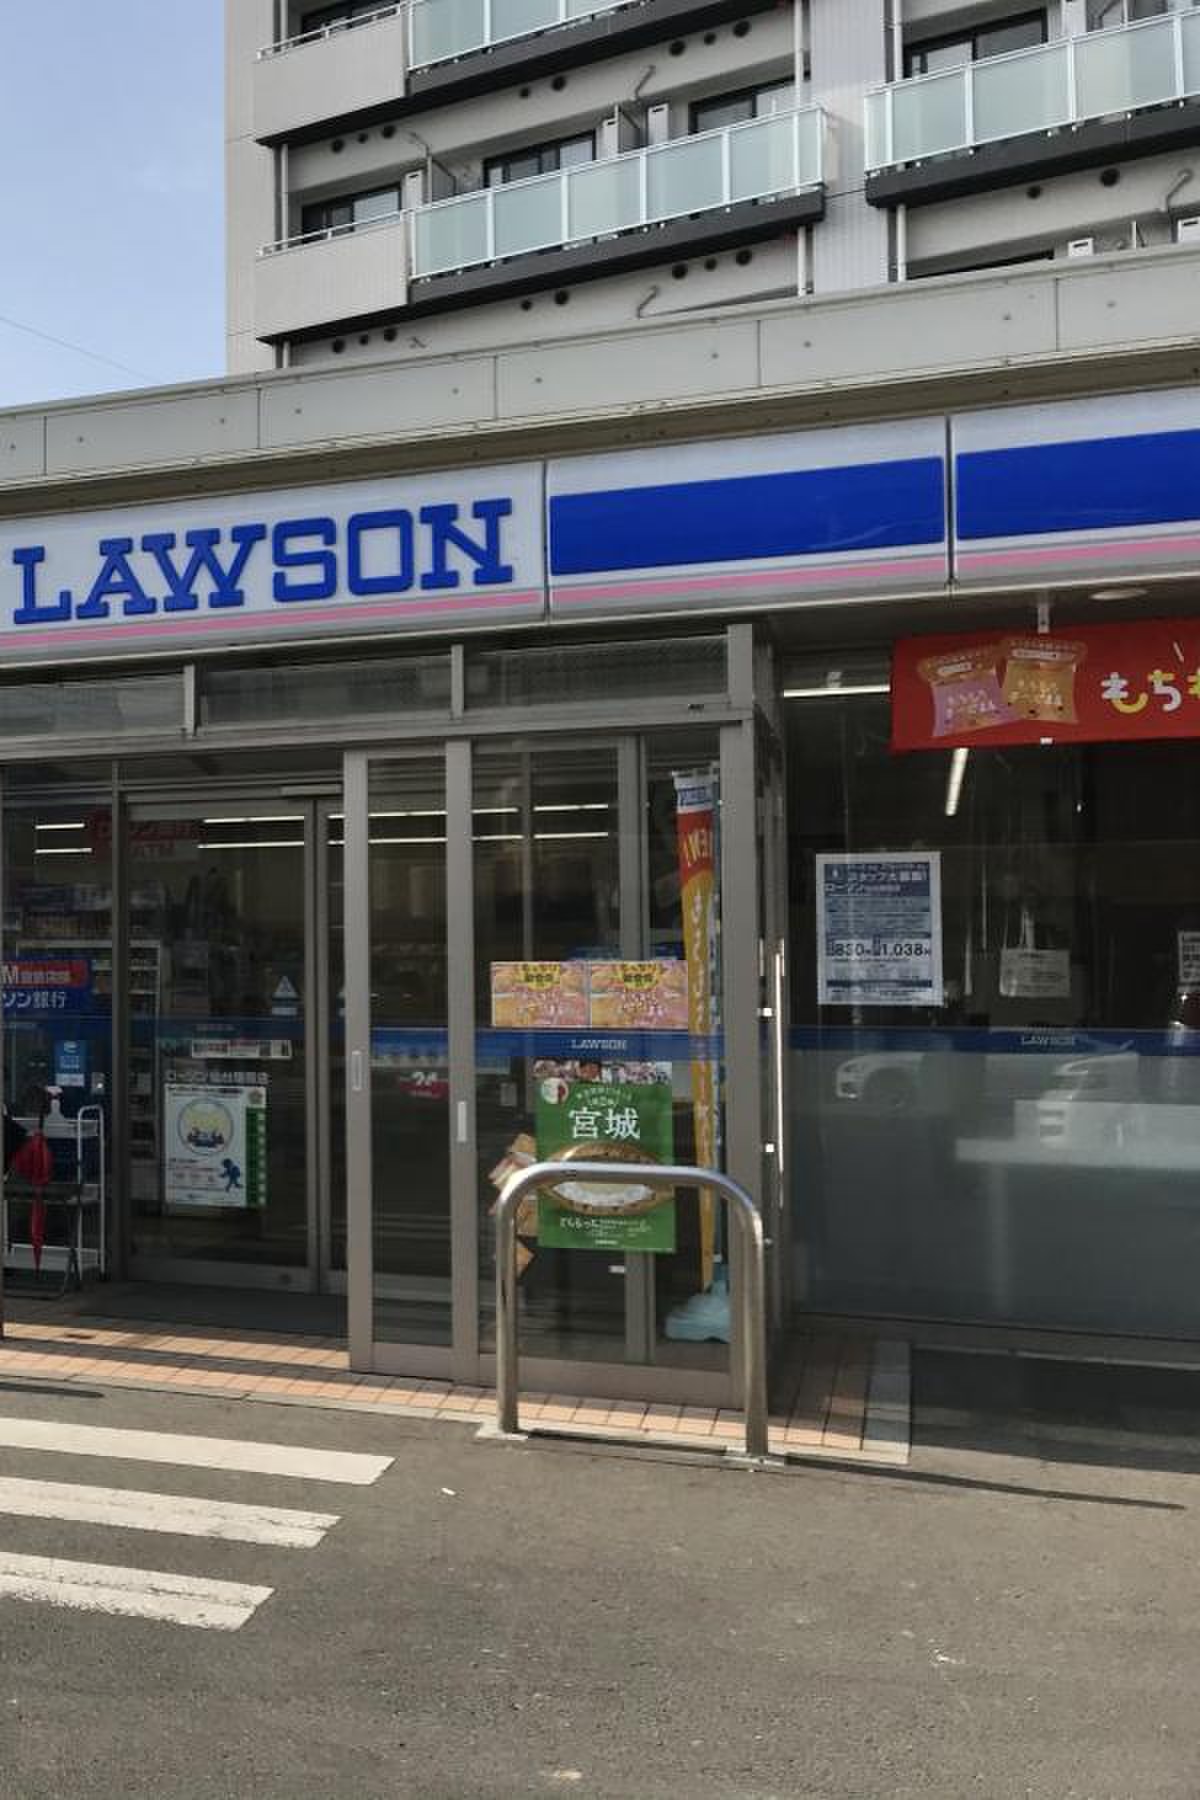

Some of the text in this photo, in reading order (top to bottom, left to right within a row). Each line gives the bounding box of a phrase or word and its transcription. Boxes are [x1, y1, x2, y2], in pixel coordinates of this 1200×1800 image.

[13, 498, 512, 625] LAWSON
[2, 991, 66, 1008] ソン銀行
[571, 1039, 628, 1051] LAWSON
[568, 1106, 641, 1140] 宮城
